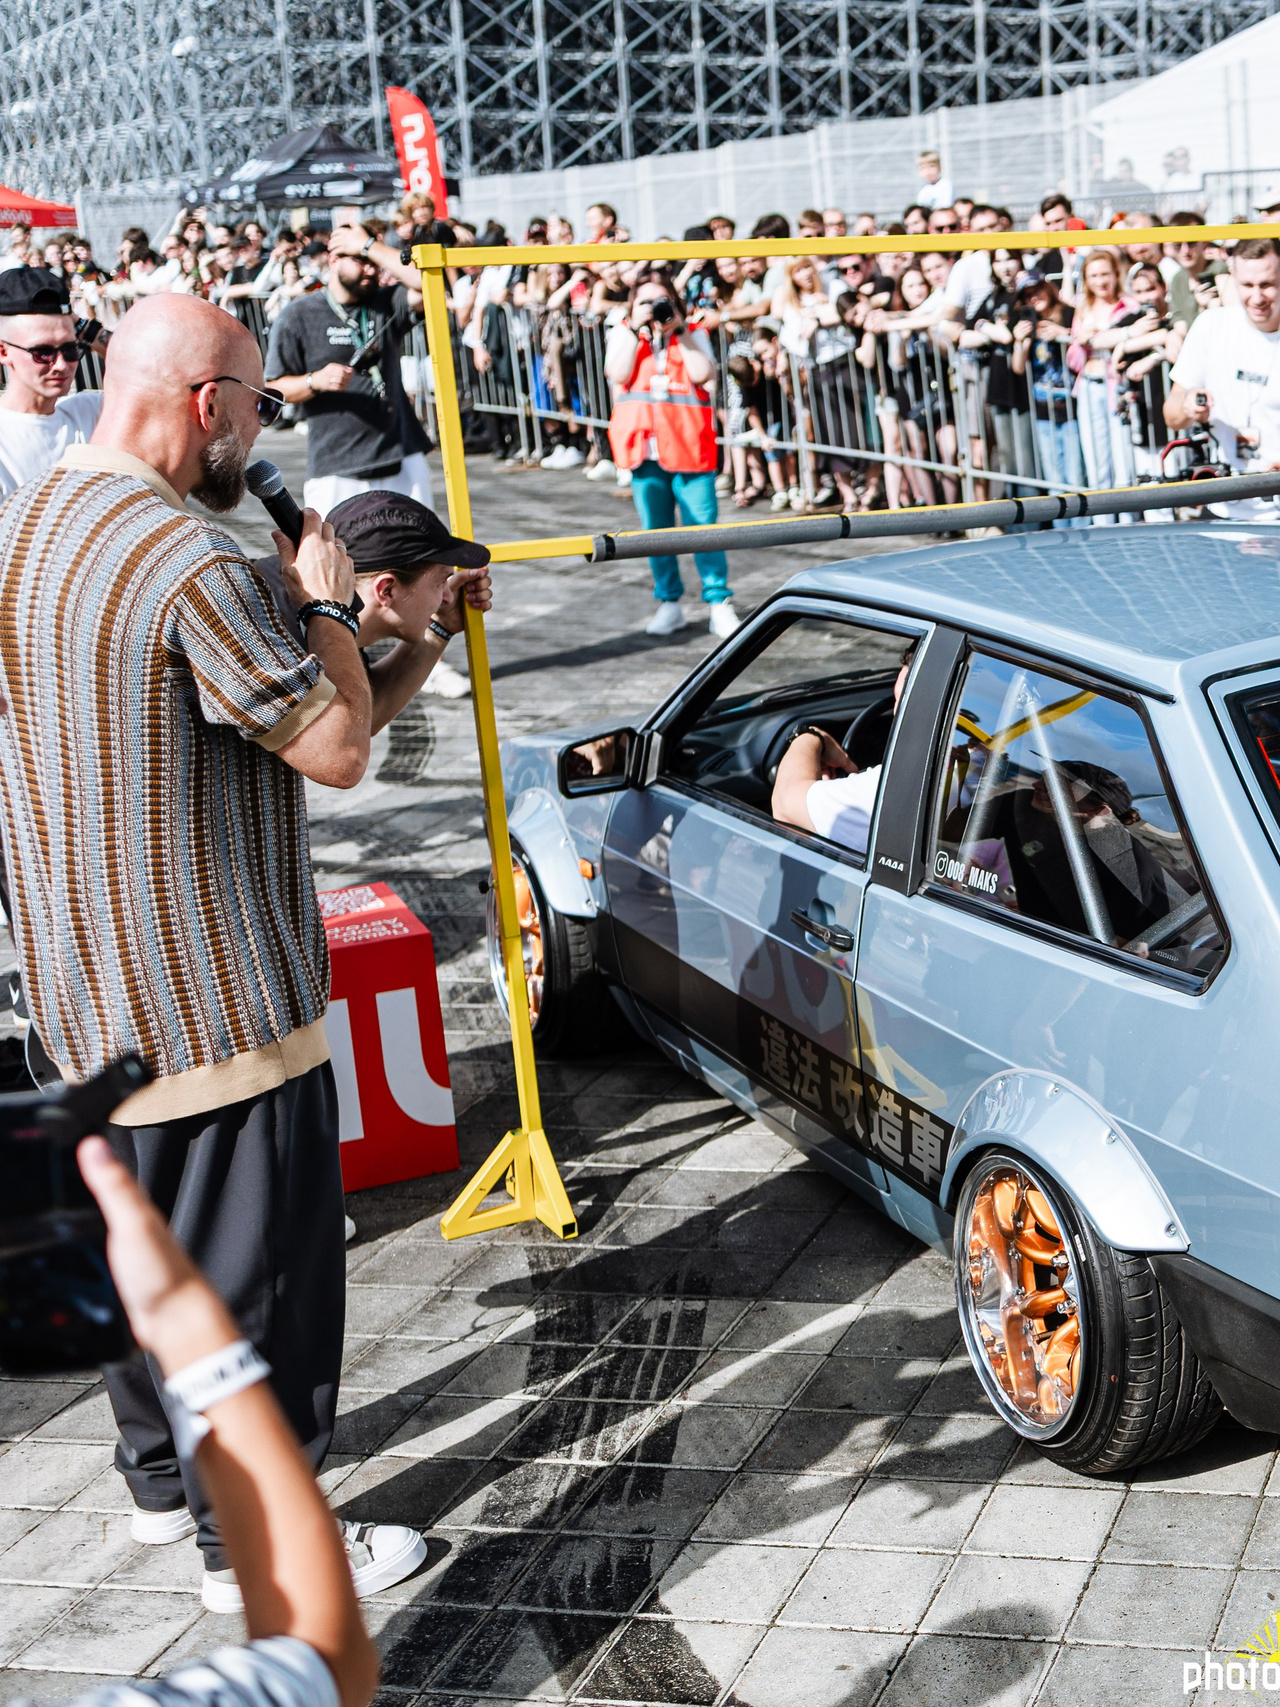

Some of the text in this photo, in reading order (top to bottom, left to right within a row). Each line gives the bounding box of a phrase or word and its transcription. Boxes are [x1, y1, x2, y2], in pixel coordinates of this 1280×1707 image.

[946, 859, 999, 894] 008_MAKS
[760, 1015, 945, 1185] 違法改造車
